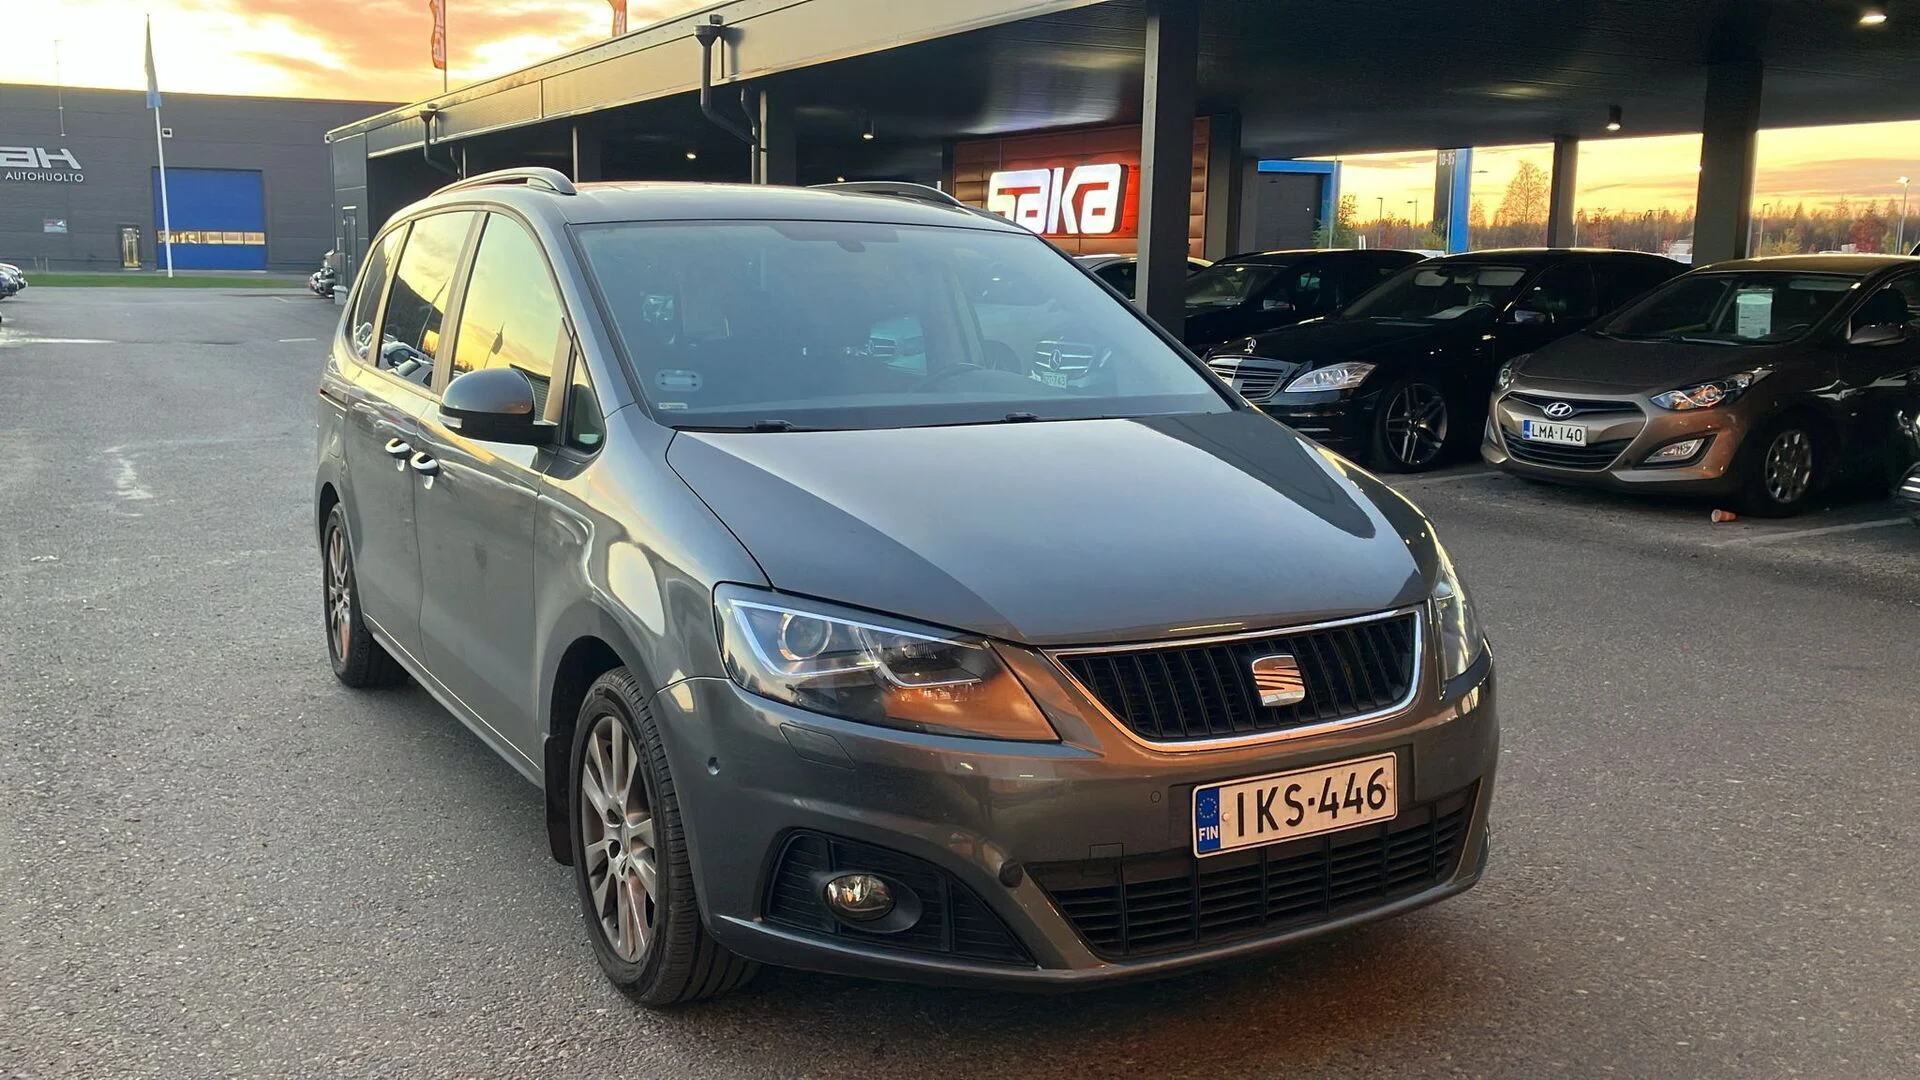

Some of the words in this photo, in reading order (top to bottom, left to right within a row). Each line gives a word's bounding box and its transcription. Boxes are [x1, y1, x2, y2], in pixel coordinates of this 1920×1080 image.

[5, 171, 84, 183] AUTOHUOLTO
[1532, 423, 1582, 442] LMA-140
[1237, 767, 1388, 837] IKS-446
[1198, 825, 1219, 842] FIN
